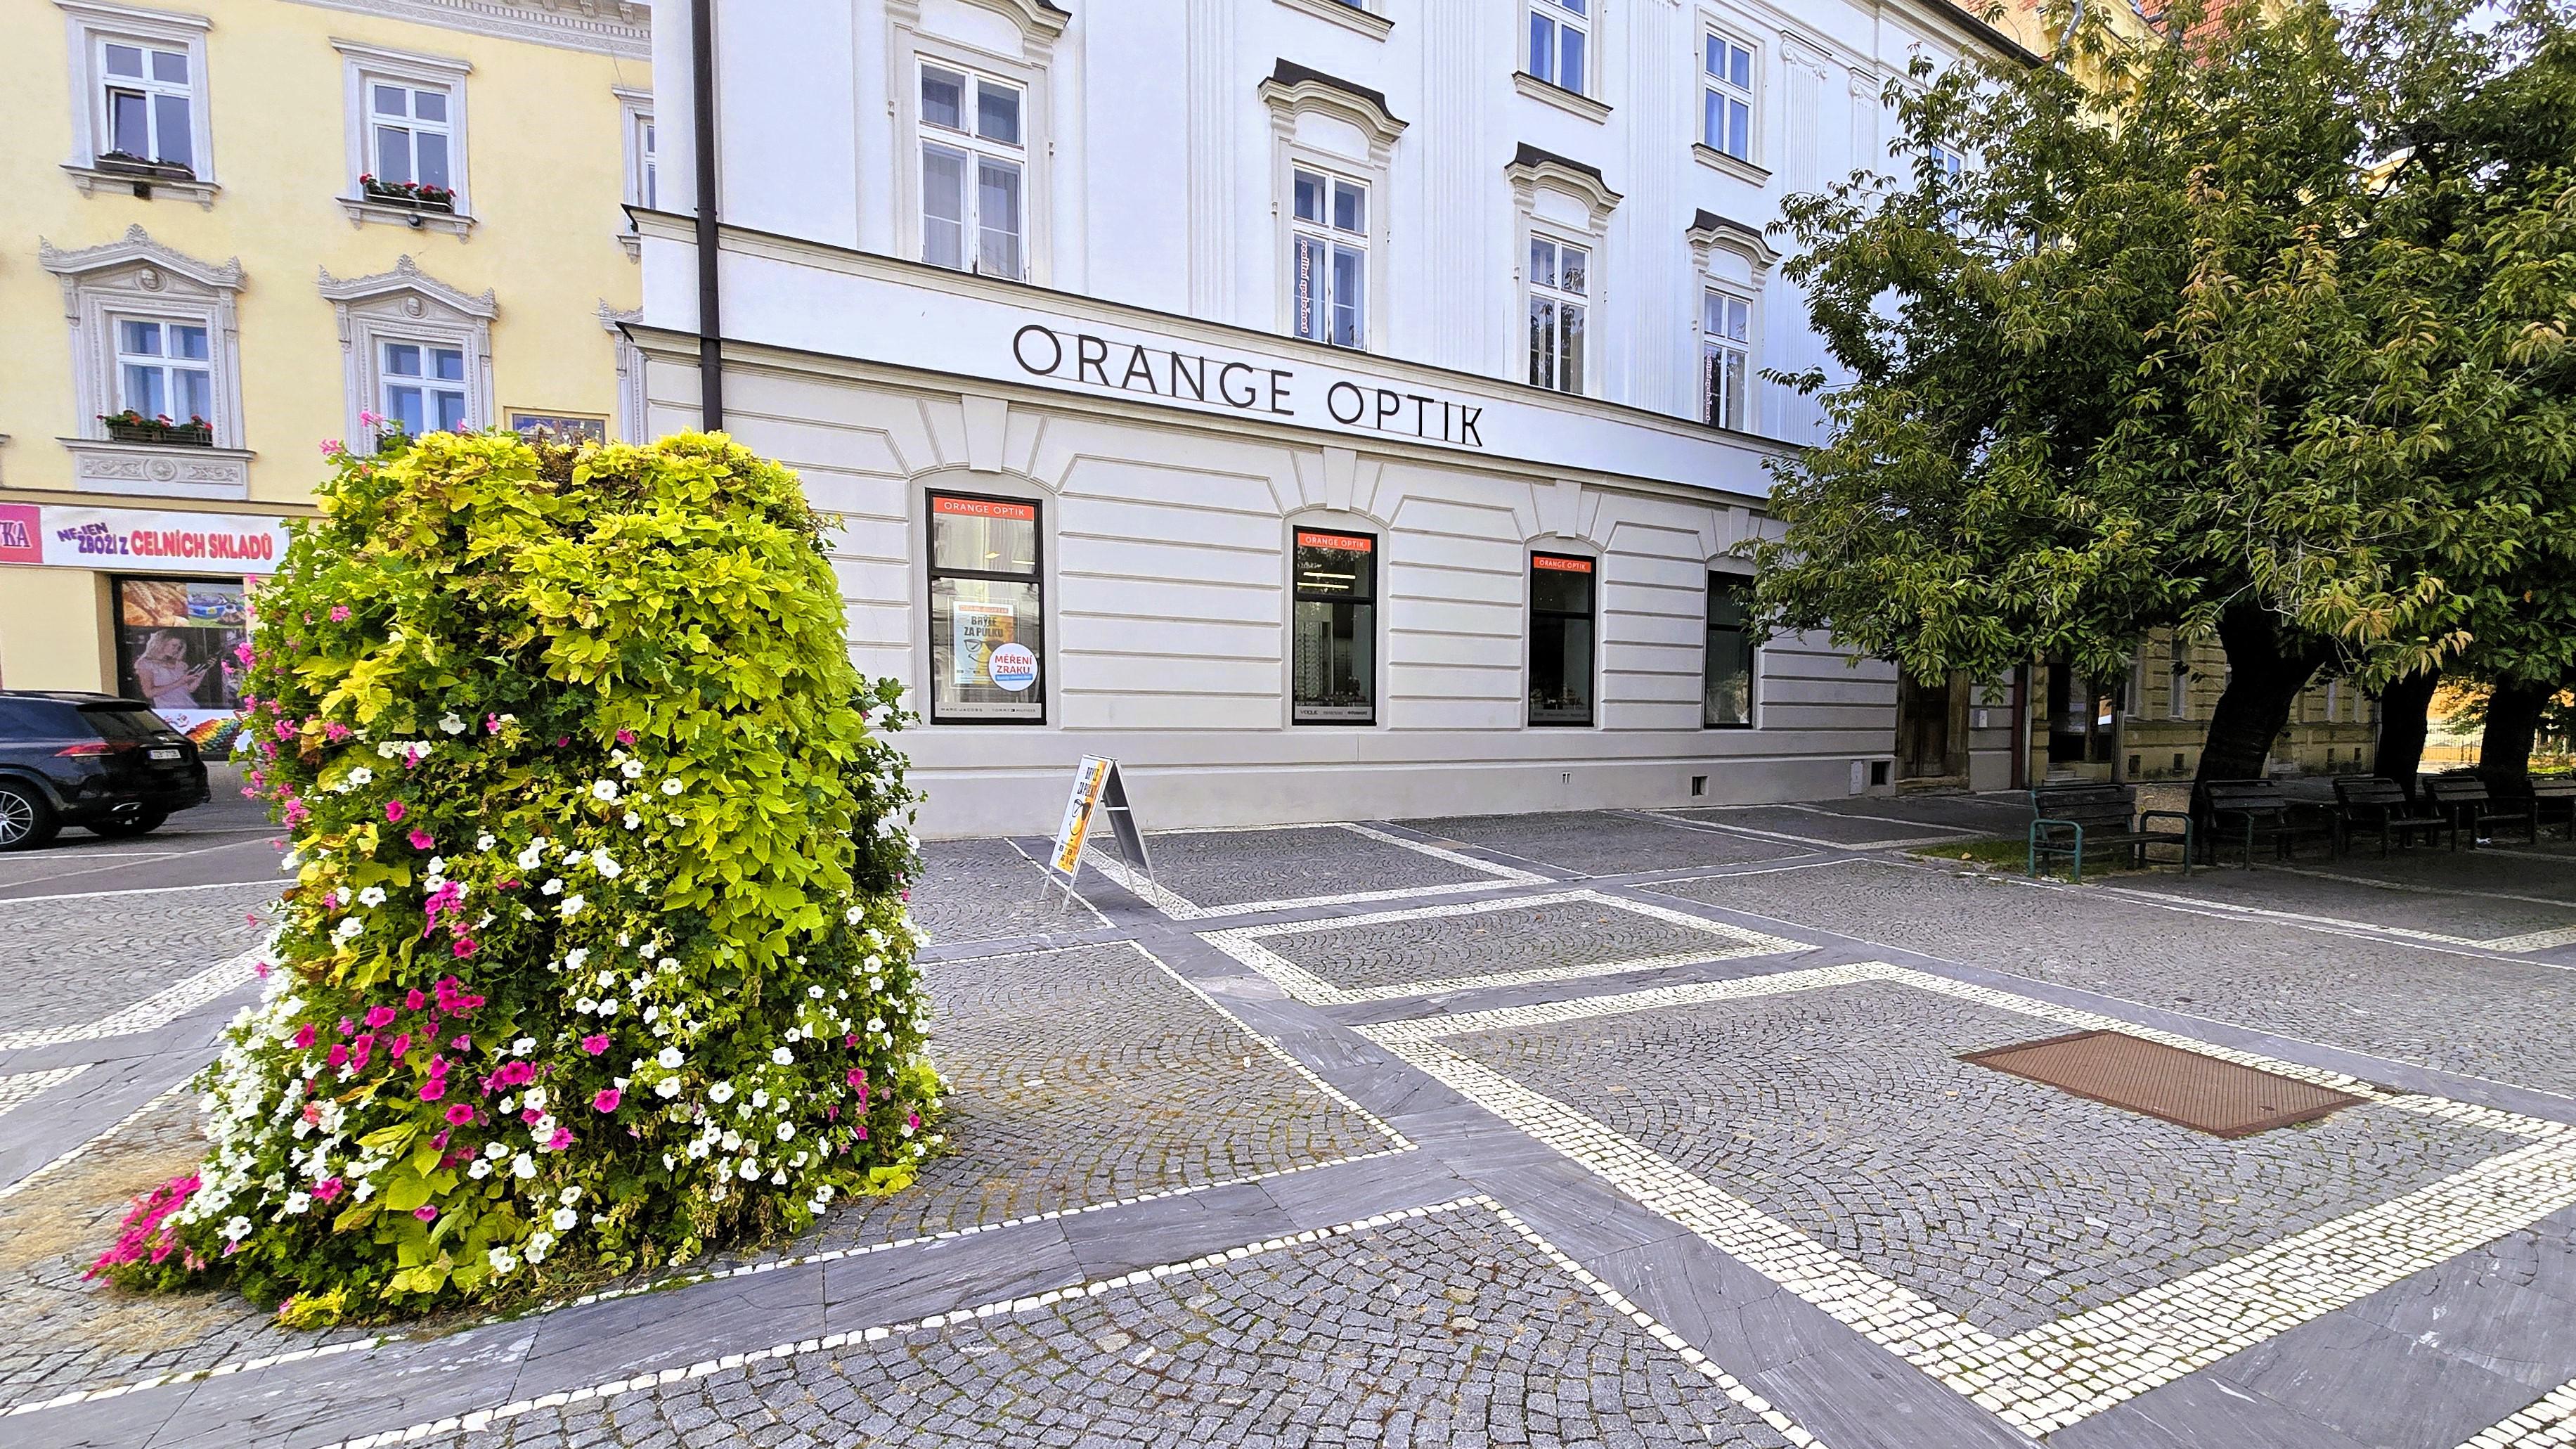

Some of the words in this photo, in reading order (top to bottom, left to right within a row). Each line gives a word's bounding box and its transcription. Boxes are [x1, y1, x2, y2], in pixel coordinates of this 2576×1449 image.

[1300, 240, 1309, 280] realitní
[1299, 280, 1311, 333] společnost
[1013, 324, 1295, 416] ORANGE
[1327, 381, 1483, 447] OPTIK
[944, 502, 989, 514] ORANGE
[993, 506, 1025, 516] OPTIK
[119, 536, 129, 555] Z
[131, 529, 206, 558] CELNÍCH
[209, 532, 273, 560] SKLADŮ
[1305, 536, 1338, 546] ORANGE
[1341, 539, 1364, 548] OPTIK
[1539, 559, 1565, 569] ORANGE
[964, 626, 974, 636] ZA
[995, 654, 1033, 665] MĚŘENÍ
[997, 665, 1030, 674] ZRAKU
